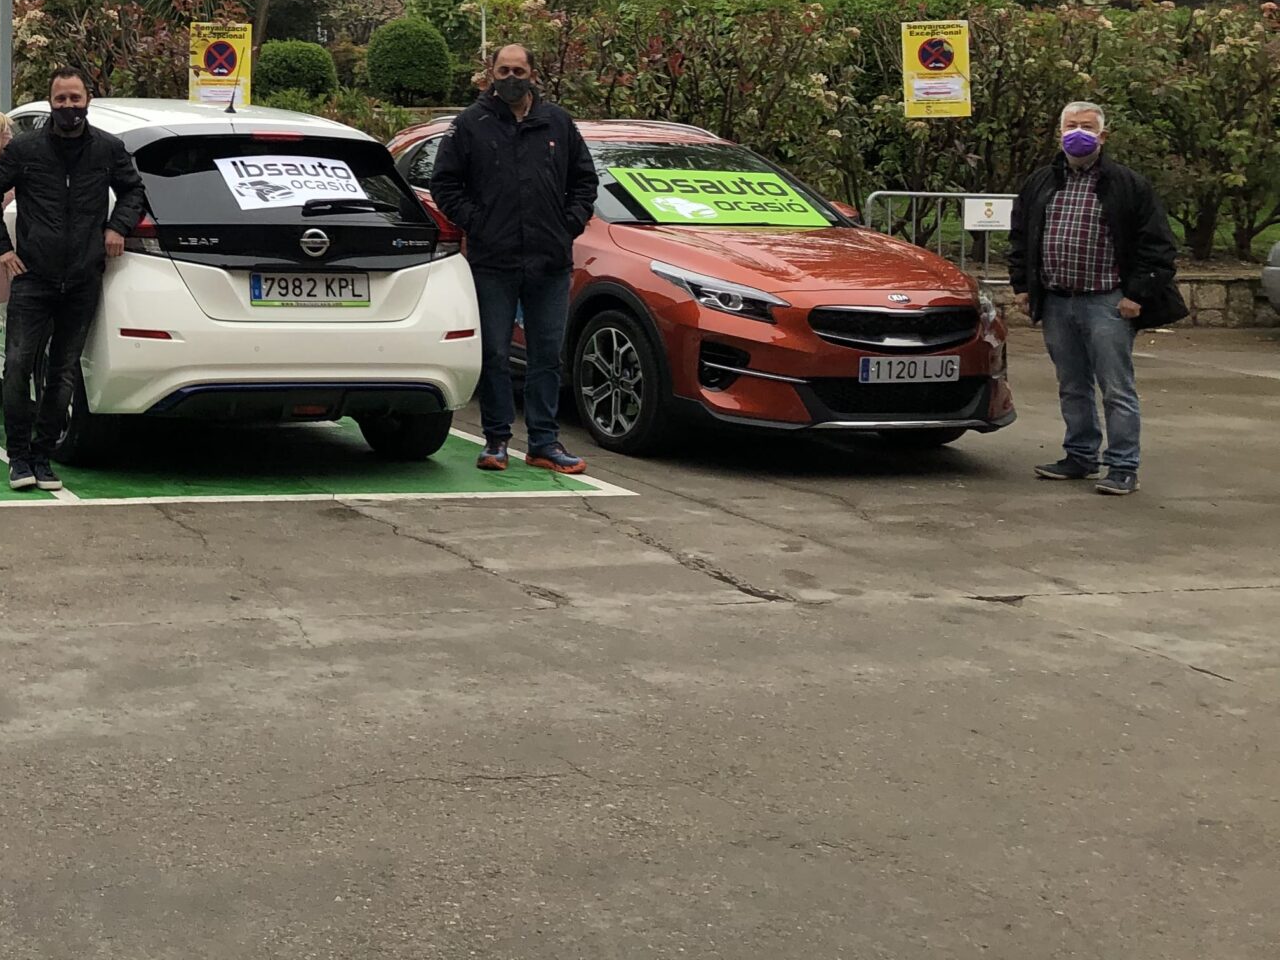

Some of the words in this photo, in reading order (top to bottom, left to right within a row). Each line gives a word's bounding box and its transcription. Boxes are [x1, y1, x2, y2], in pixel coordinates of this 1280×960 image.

[909, 29, 962, 37] Excepcional
[290, 179, 358, 192] ocasió
[713, 198, 809, 213] ocasió
[178, 237, 219, 246] LEAF
[264, 277, 318, 298] 7982
[325, 277, 363, 297] KPL
[875, 360, 918, 379] 1120
[923, 359, 955, 378] LJG
